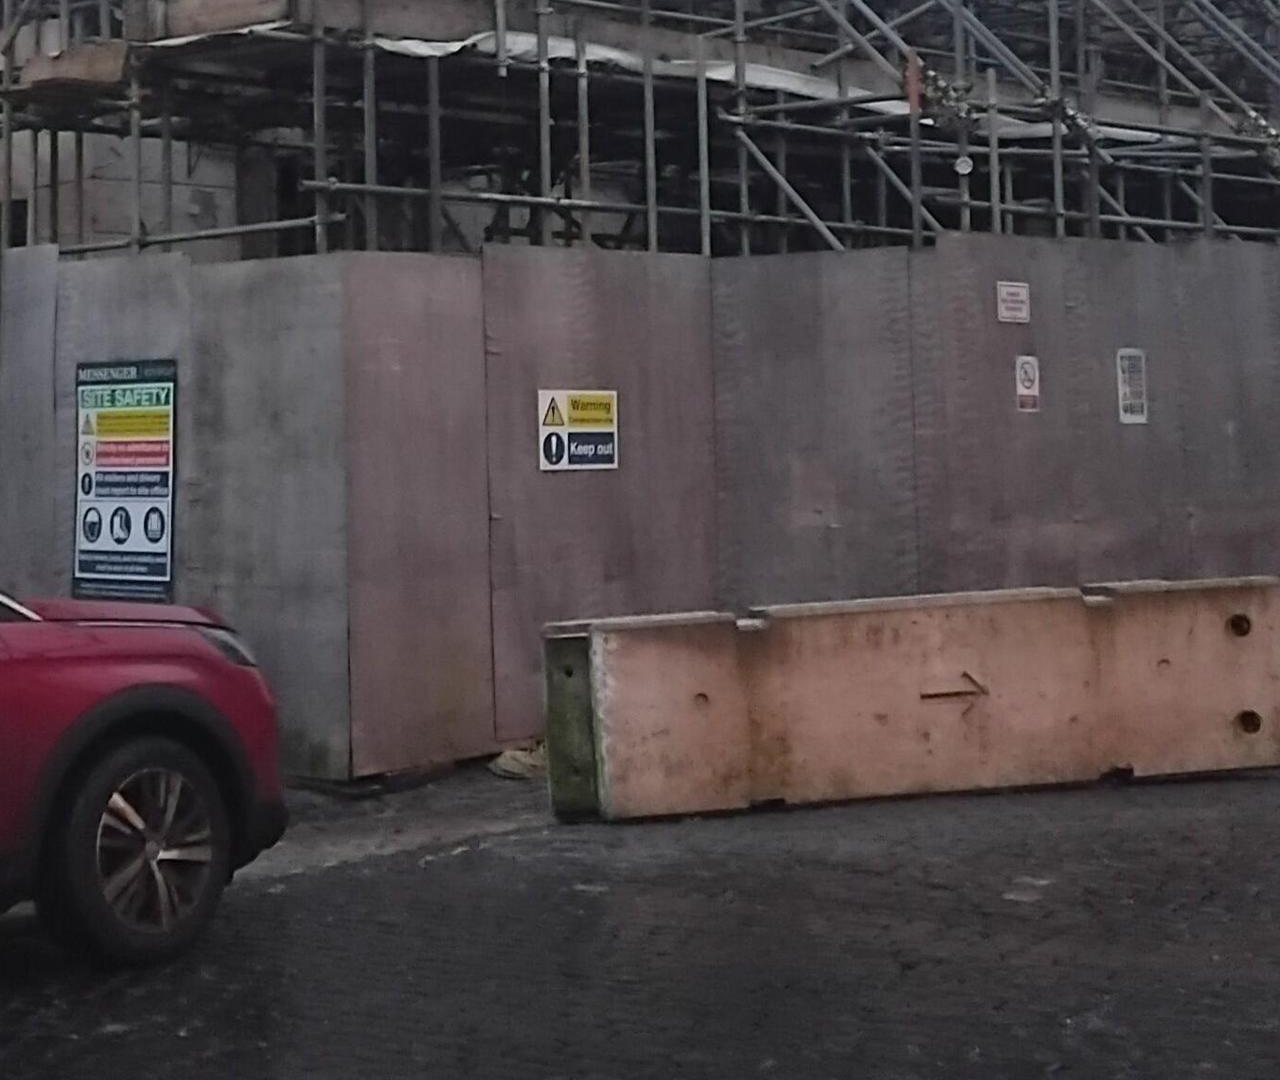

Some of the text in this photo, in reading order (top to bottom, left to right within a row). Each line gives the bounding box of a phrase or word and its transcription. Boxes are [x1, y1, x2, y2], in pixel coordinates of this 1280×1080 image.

[79, 367, 138, 380] MESSENGER
[83, 387, 168, 407] SITE SAFETY
[571, 399, 611, 415] Warning
[570, 441, 613, 457] Keep out
